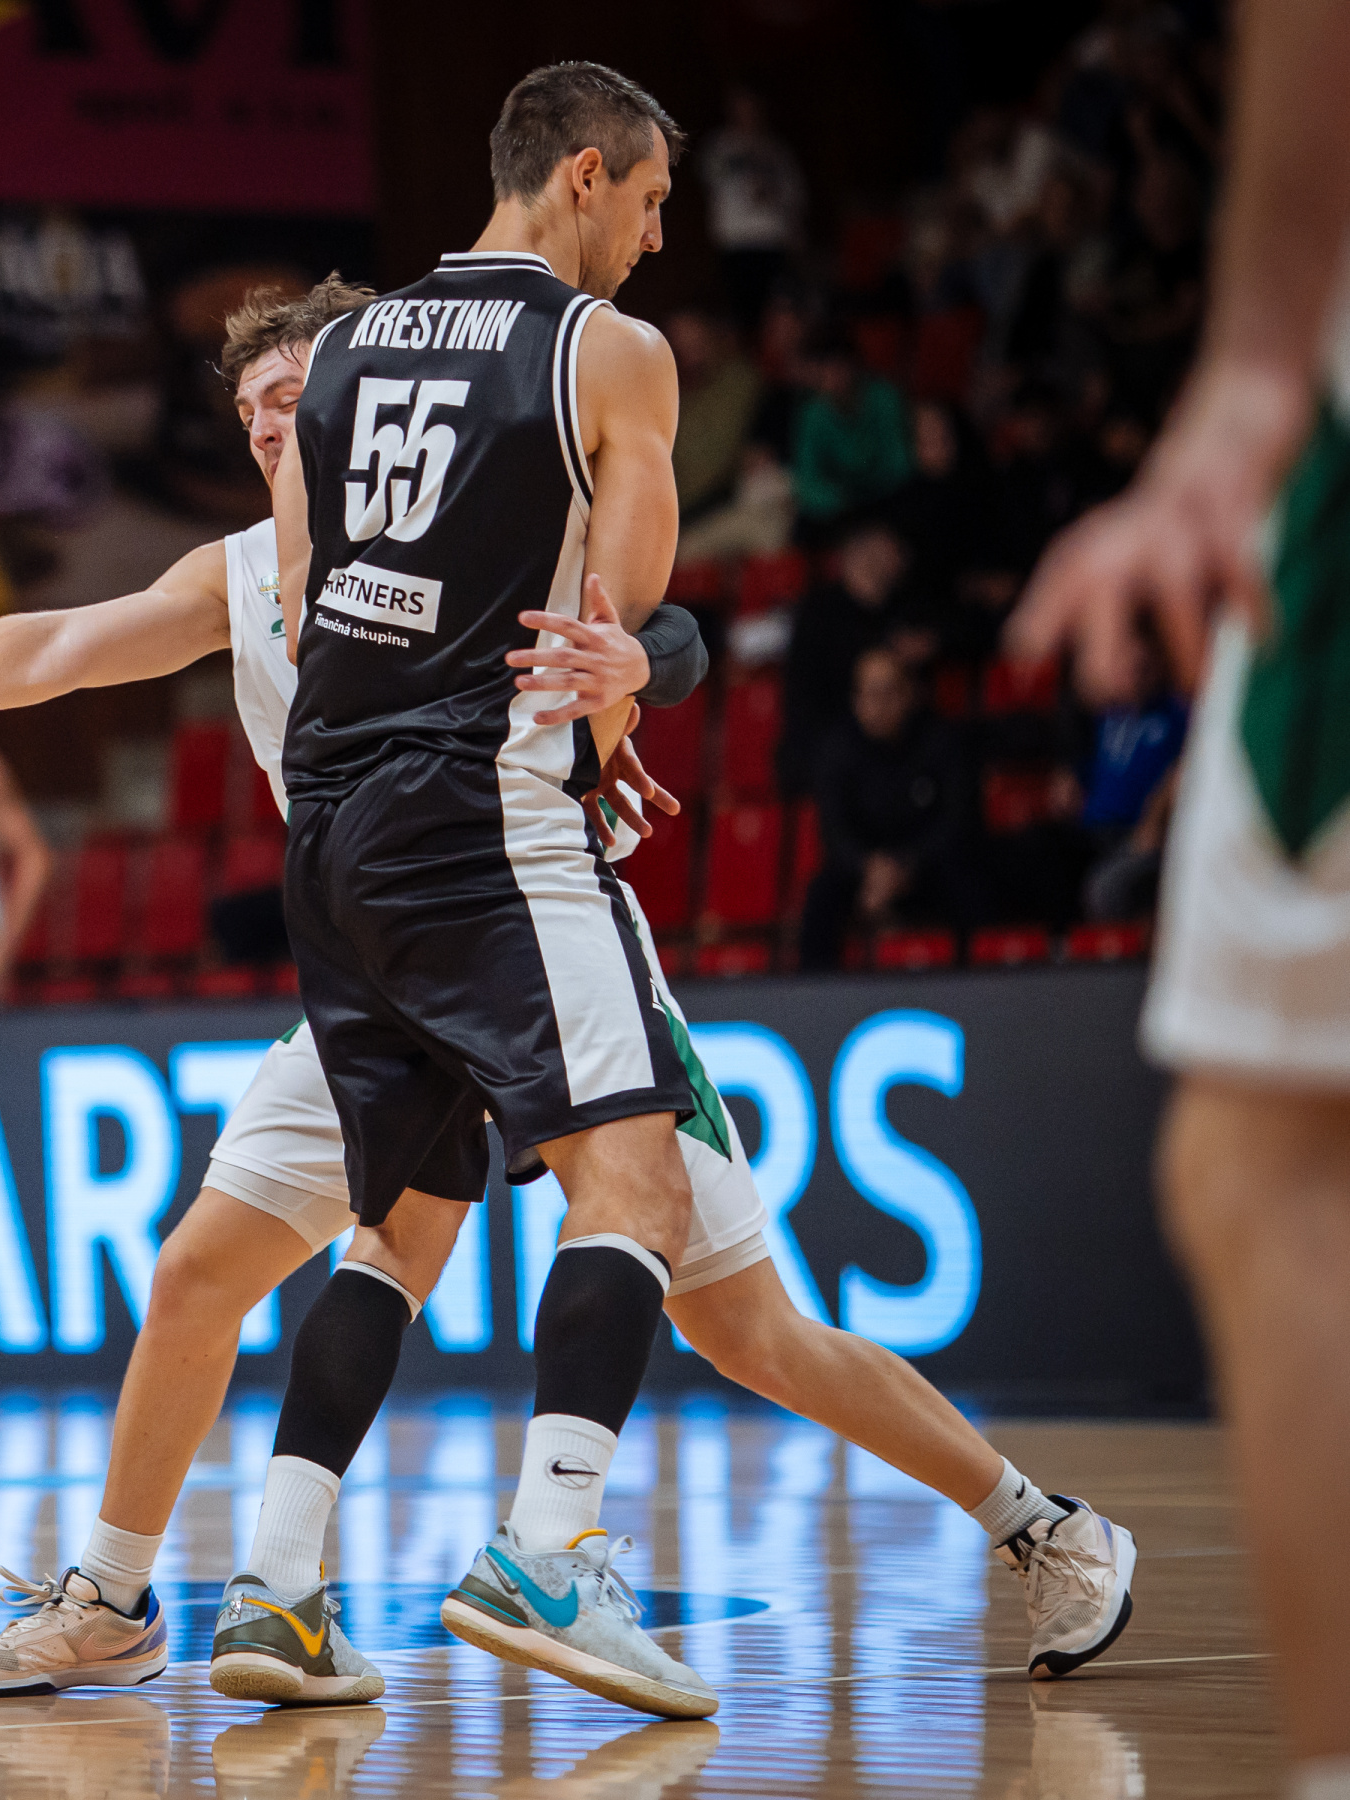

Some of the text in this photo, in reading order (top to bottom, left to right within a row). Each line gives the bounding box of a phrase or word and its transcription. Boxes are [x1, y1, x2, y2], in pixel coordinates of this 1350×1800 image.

[348, 299, 526, 351] KRESTININ
[344, 376, 471, 542] 55
[352, 626, 410, 647] skupina
